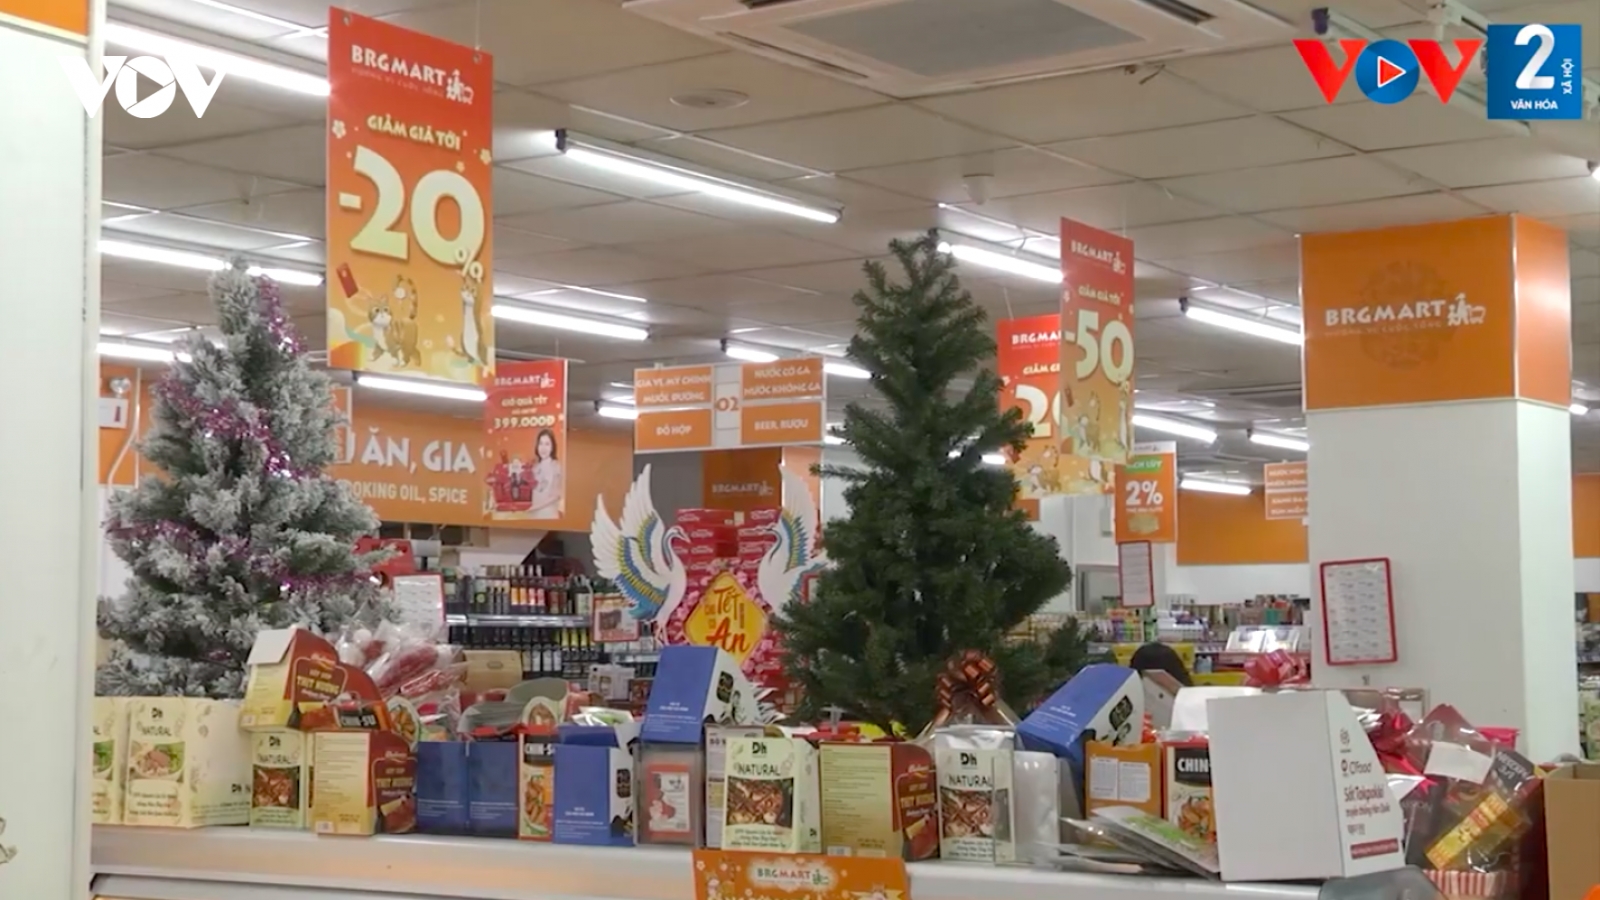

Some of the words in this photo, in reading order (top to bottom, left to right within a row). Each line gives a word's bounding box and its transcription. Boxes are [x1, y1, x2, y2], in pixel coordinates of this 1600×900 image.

[352, 45, 446, 86] BRGMART
[367, 114, 408, 138] GIẢM
[409, 125, 435, 144] GIÁ
[435, 130, 461, 150] TỚI
[1325, 299, 1447, 326] BRGMART
[1012, 330, 1061, 345] BRGMA
[361, 426, 417, 474] ĂN,
[422, 440, 476, 474] GIA
[350, 481, 397, 500] OKING
[429, 487, 468, 504] SPICE
[1125, 480, 1164, 506] 2%
[714, 585, 741, 621] Tết
[706, 616, 751, 653] An
[524, 743, 556, 755] CHIN-S
[752, 742, 767, 754] Dh
[961, 752, 978, 766] Dh
[737, 764, 781, 776] NATURAL
[948, 774, 994, 787] NATURAL
[757, 868, 811, 880] BRGMART
